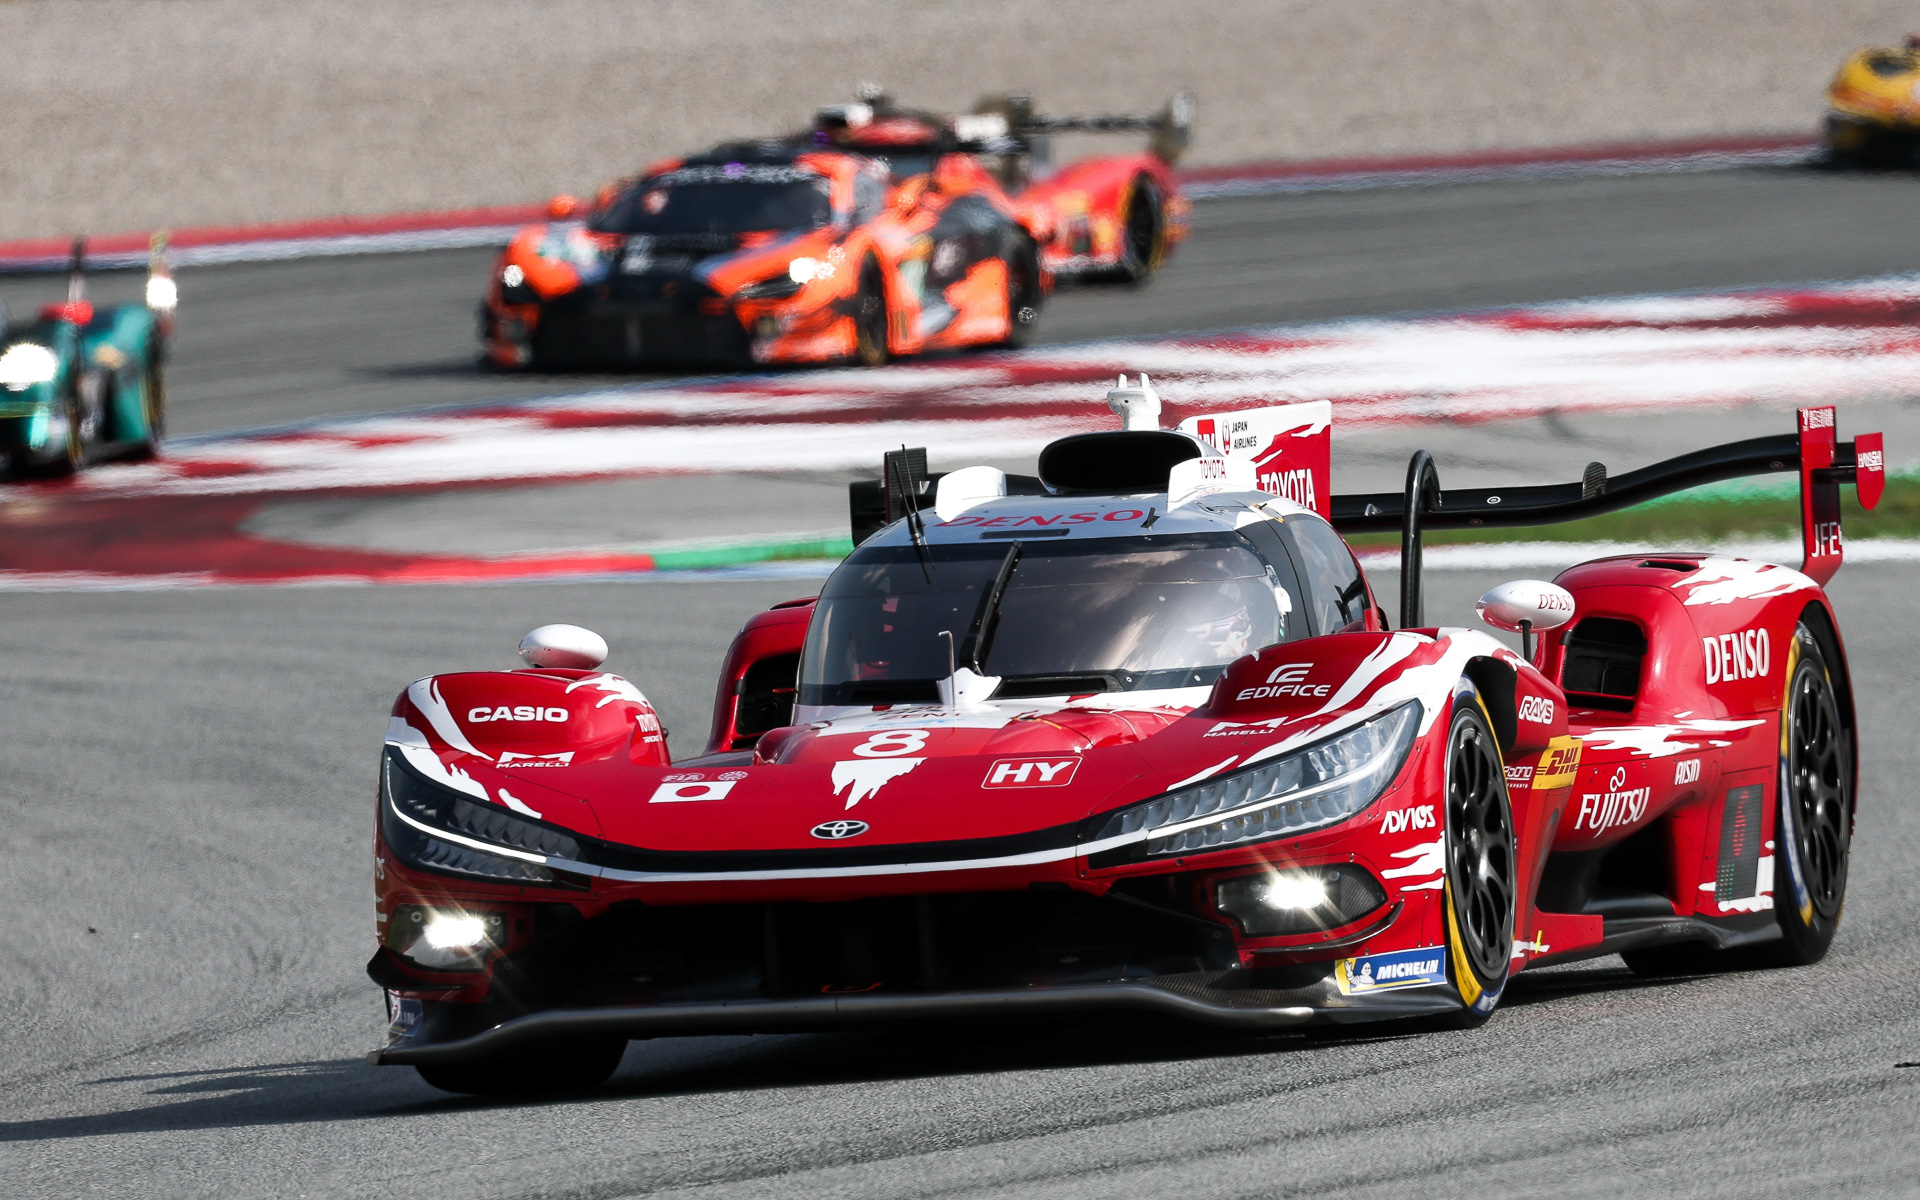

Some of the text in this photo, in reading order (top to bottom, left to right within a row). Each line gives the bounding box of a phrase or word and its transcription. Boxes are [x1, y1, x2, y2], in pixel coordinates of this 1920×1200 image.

[1231, 421, 1248, 434] JAPAN
[1233, 436, 1257, 450] AIRLINES
[1199, 460, 1226, 479] TOYOTA
[1260, 468, 1317, 511] TOYOTA
[933, 510, 1144, 527] DENSO
[1537, 594, 1573, 611] DENSO
[1702, 628, 1770, 685] DENSO
[1236, 684, 1331, 701] EDIFICE
[468, 706, 569, 723] CASIO
[1518, 695, 1554, 725] RAYS
[852, 728, 931, 757] 8
[1202, 729, 1275, 738] MARELLI
[990, 760, 1074, 783] HY
[1543, 747, 1580, 776] DHL
[1674, 758, 1701, 786] AISIN
[1574, 786, 1651, 838] FUJITSU
[1376, 959, 1439, 981] MICHELIN
